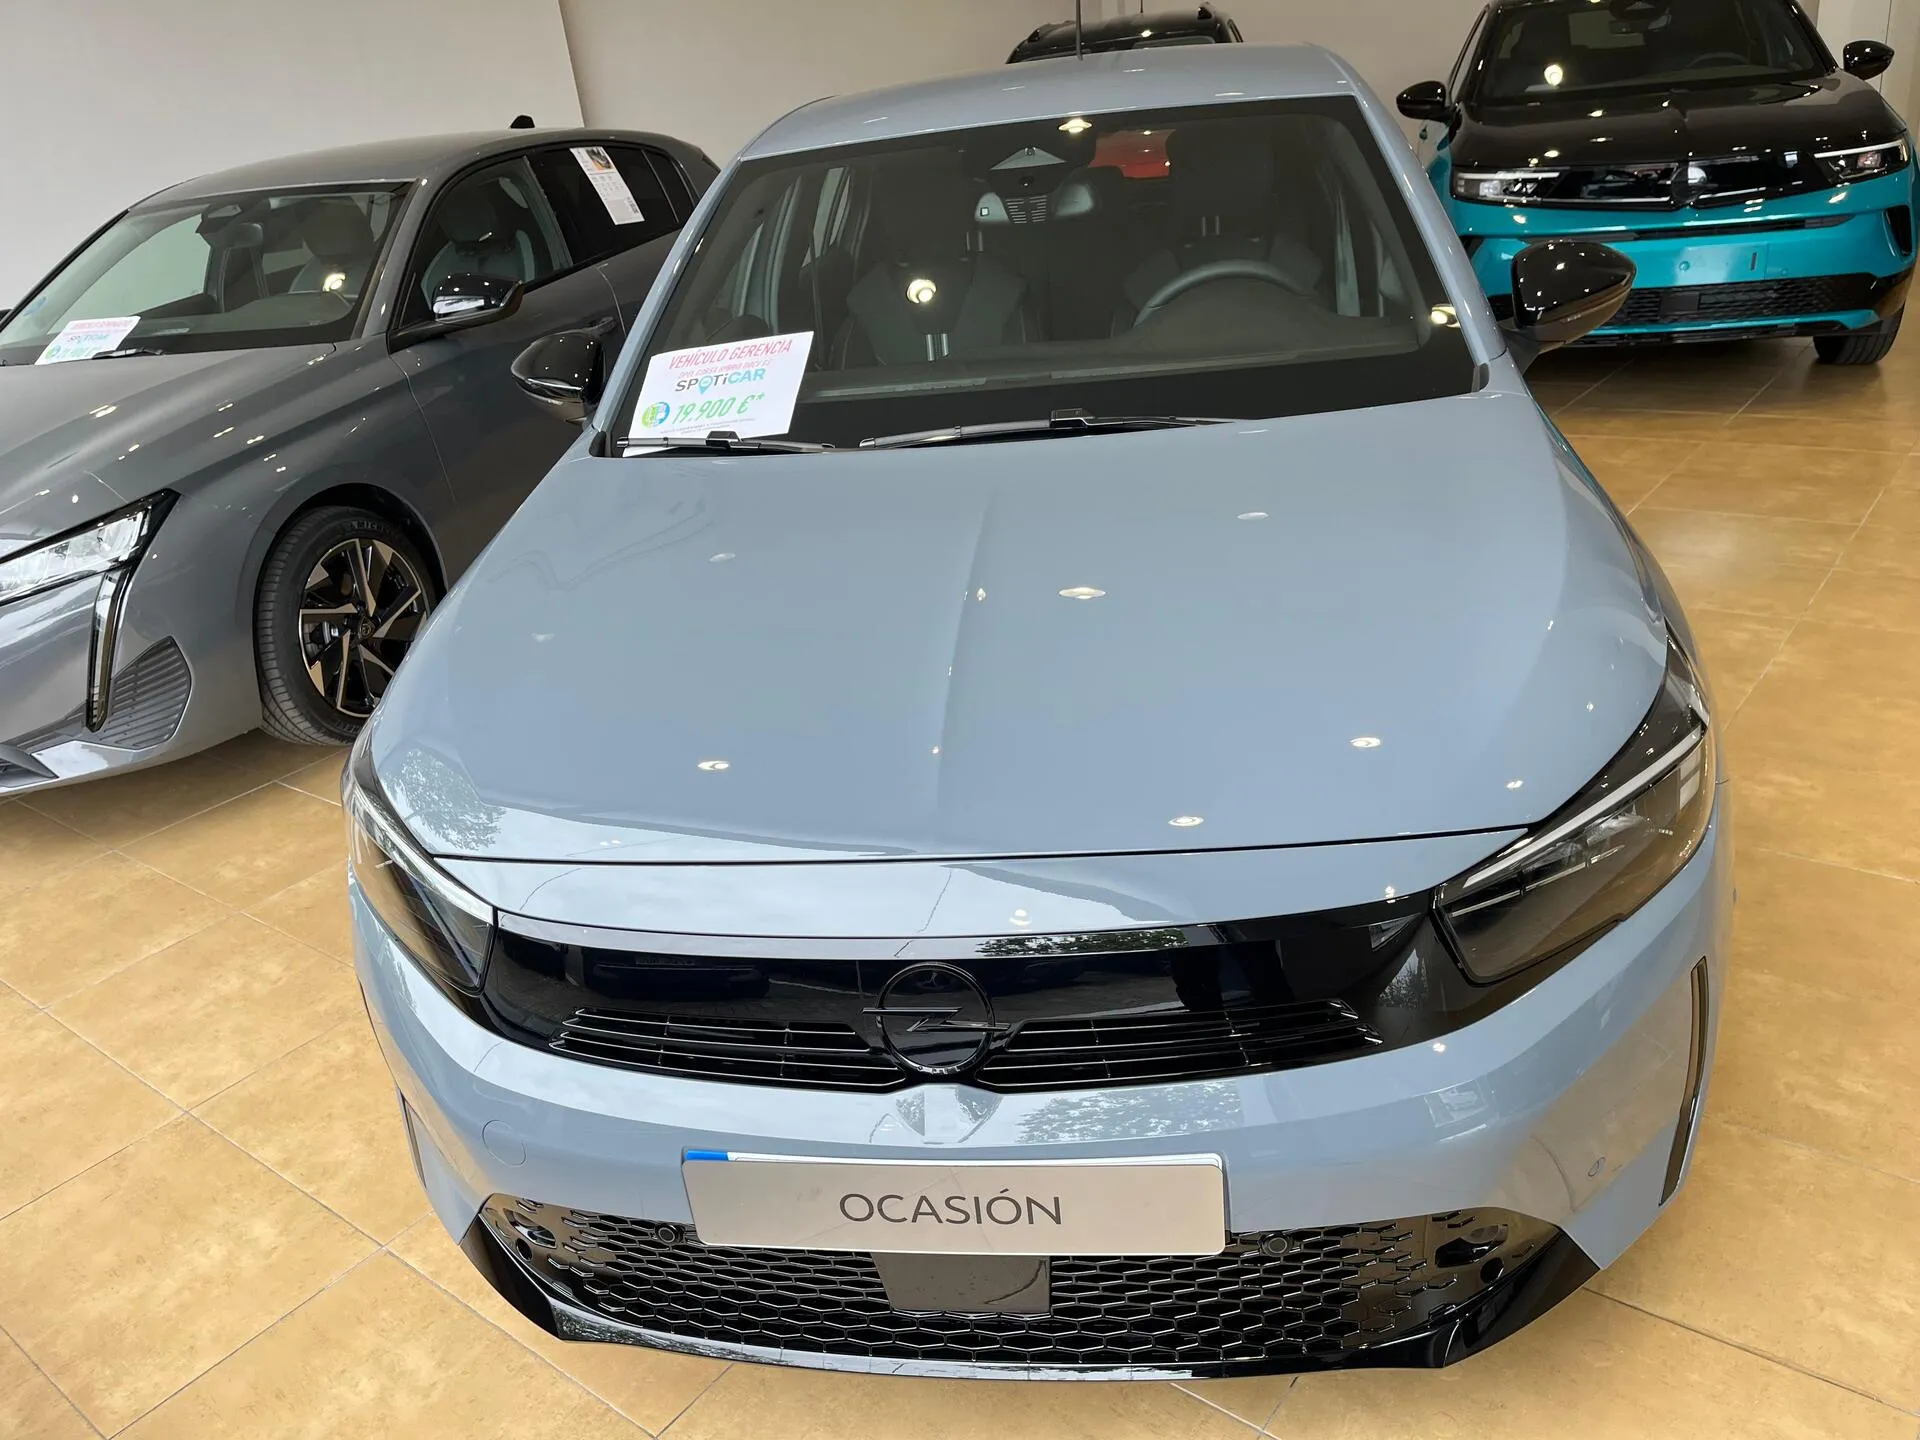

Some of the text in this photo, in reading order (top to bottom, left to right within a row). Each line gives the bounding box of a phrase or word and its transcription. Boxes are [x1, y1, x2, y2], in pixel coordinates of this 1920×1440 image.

[669, 349, 729, 370] VEHÍCULO
[729, 340, 792, 360] GERENCIA
[672, 397, 736, 425] 19.900
[839, 1188, 1062, 1226] OCASIÓN
